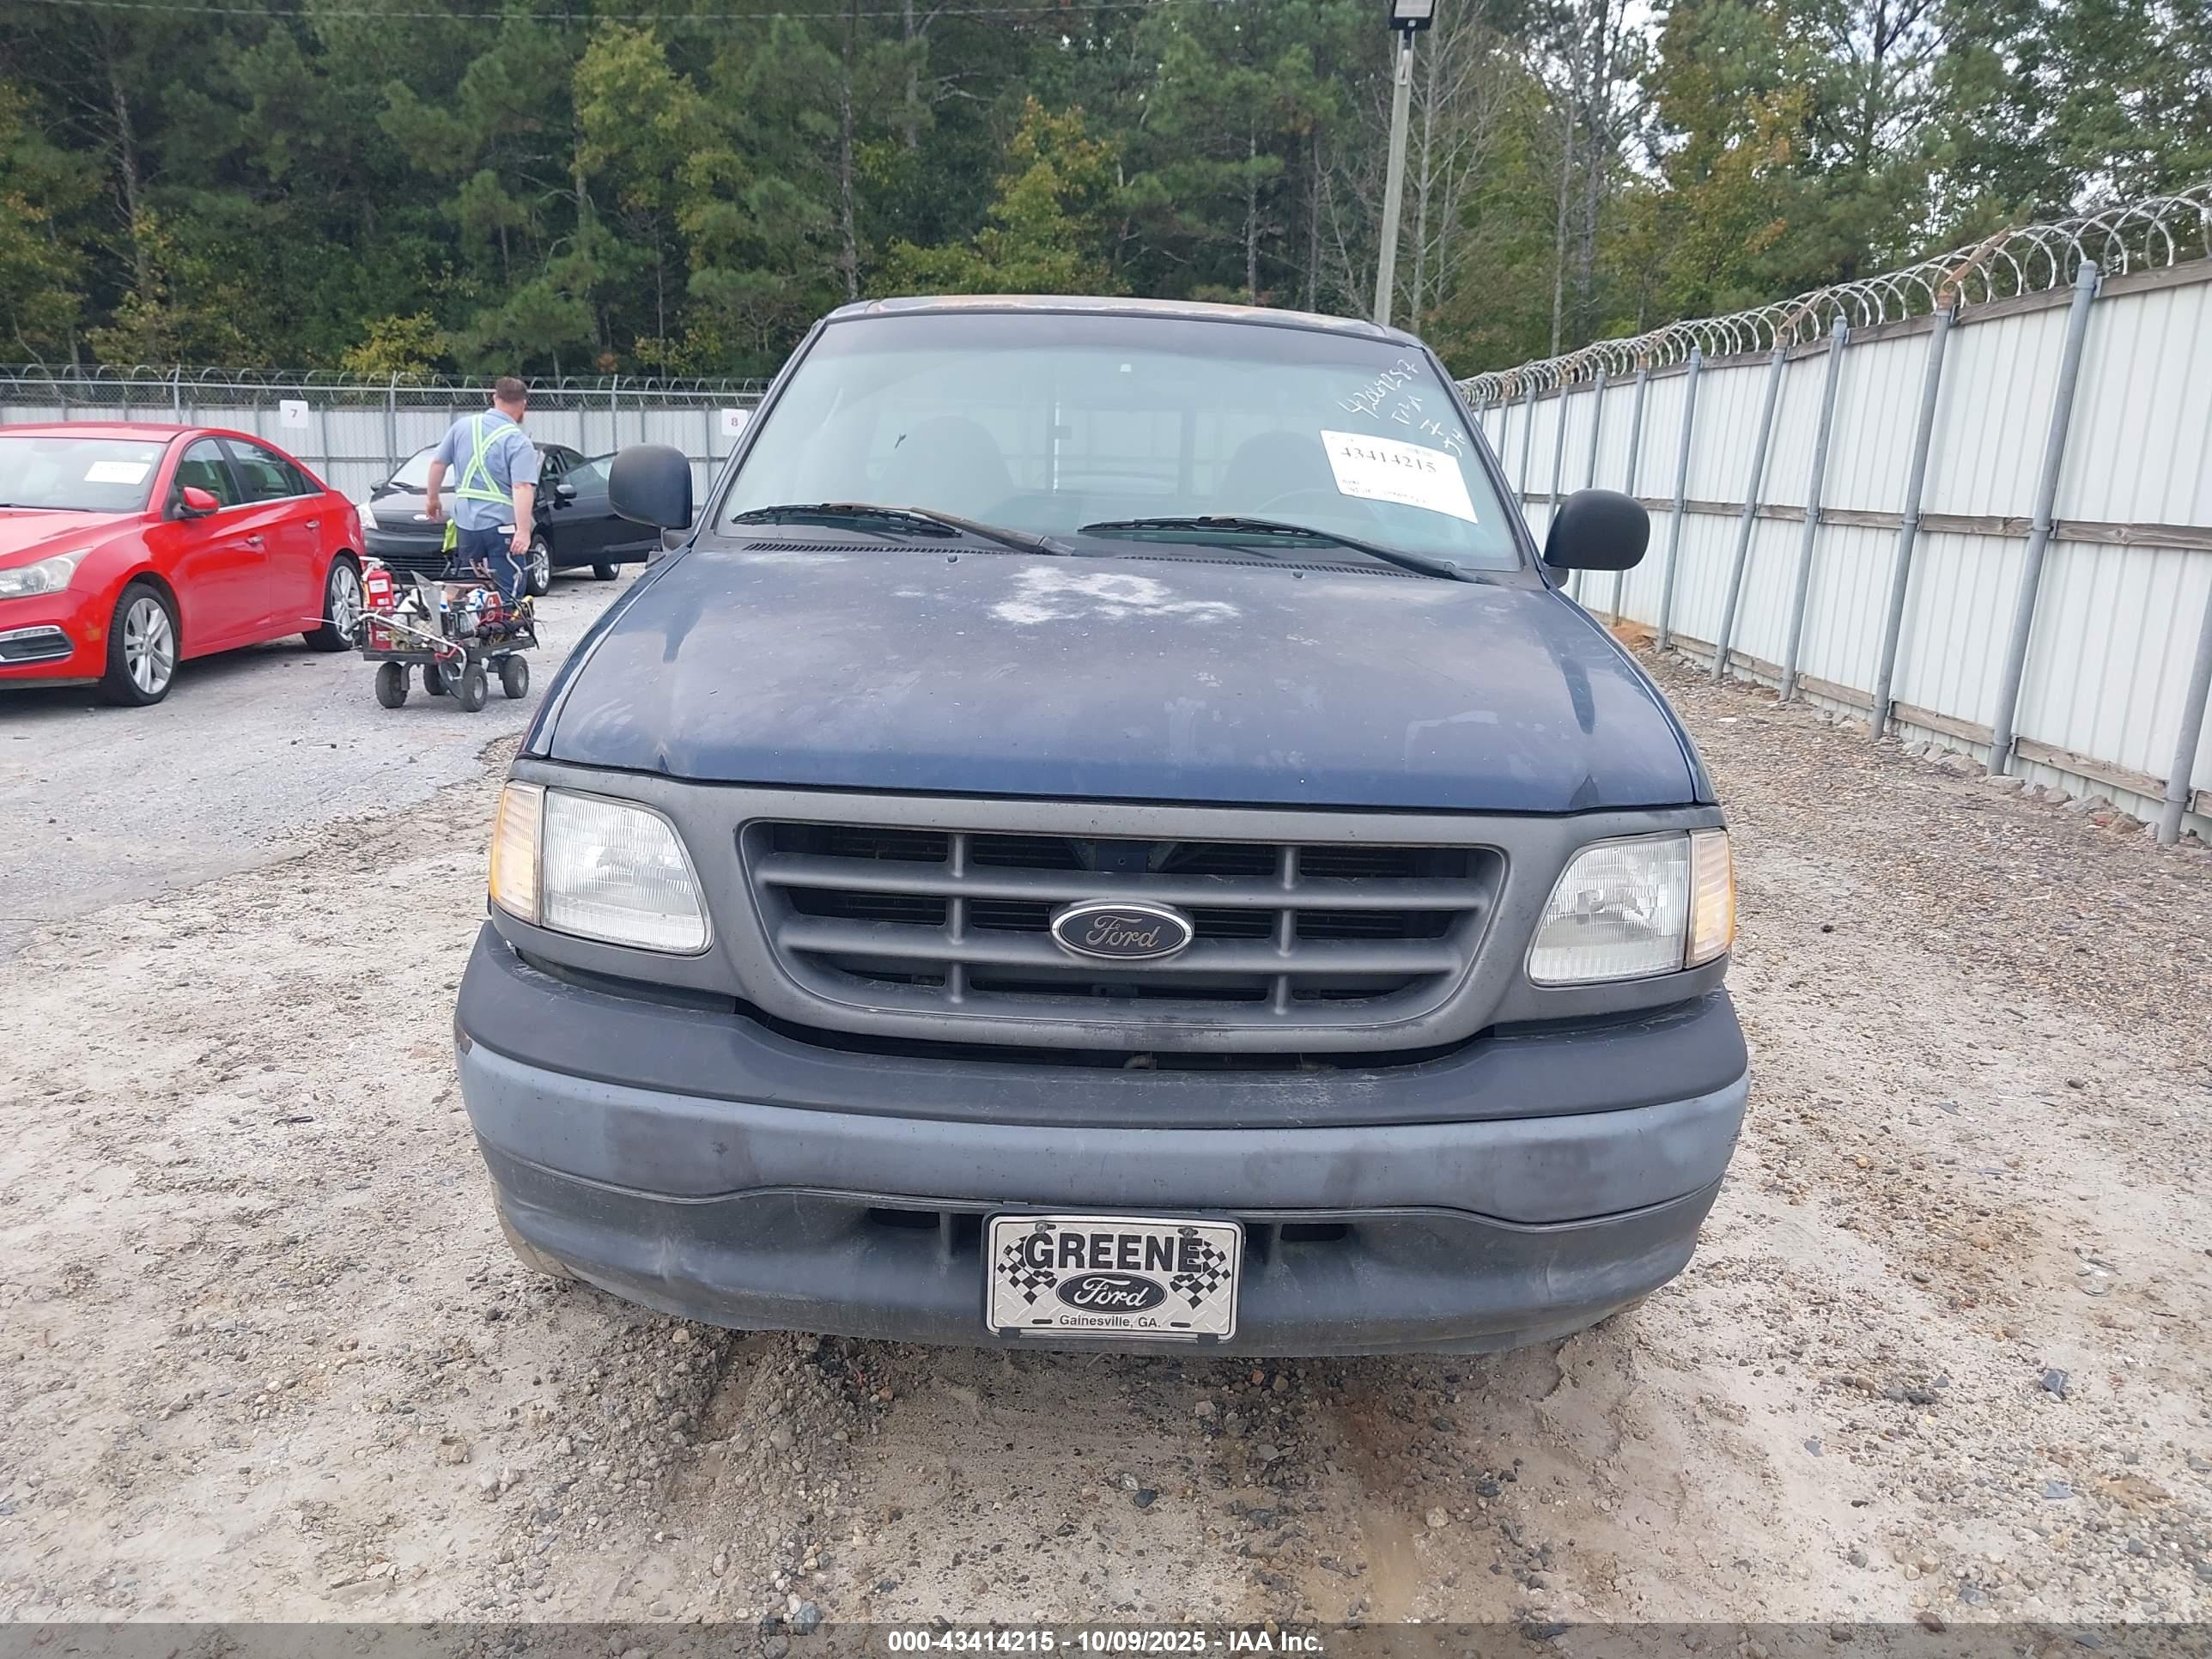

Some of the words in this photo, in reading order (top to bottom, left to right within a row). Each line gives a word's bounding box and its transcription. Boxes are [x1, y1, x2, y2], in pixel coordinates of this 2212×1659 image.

[290, 409, 297, 418] 7
[731, 417, 738, 427] 8
[1340, 447, 1437, 473] 43414215
[1085, 915, 1162, 948] Ford
[1024, 1231, 1204, 1273] GREENE
[1073, 1277, 1150, 1307] Ford
[1059, 1314, 1134, 1328] Gainesville,
[1138, 1316, 1162, 1328] GA.
